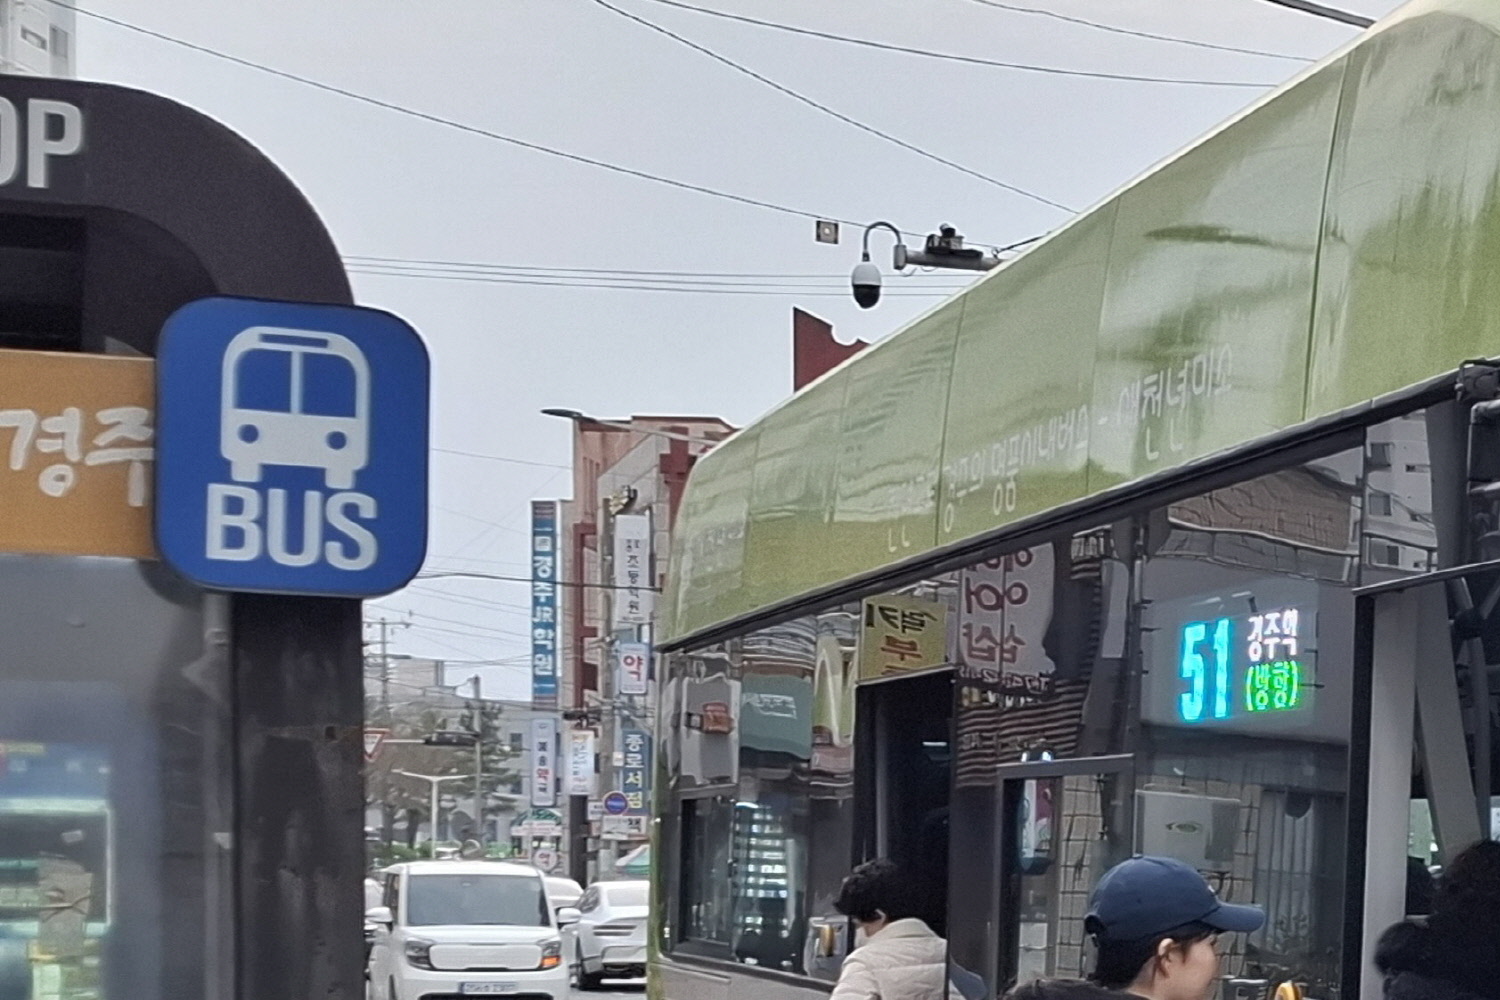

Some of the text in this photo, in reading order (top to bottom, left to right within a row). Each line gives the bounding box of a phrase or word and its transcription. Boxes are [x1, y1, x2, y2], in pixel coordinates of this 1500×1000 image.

[0, 406, 154, 508] 경주
[204, 482, 379, 572] BUS
[623, 656, 643, 681] 약
[1181, 618, 1229, 720] 51
[1247, 608, 1298, 662] 경주역
[1246, 660, 1298, 712] (방향)
